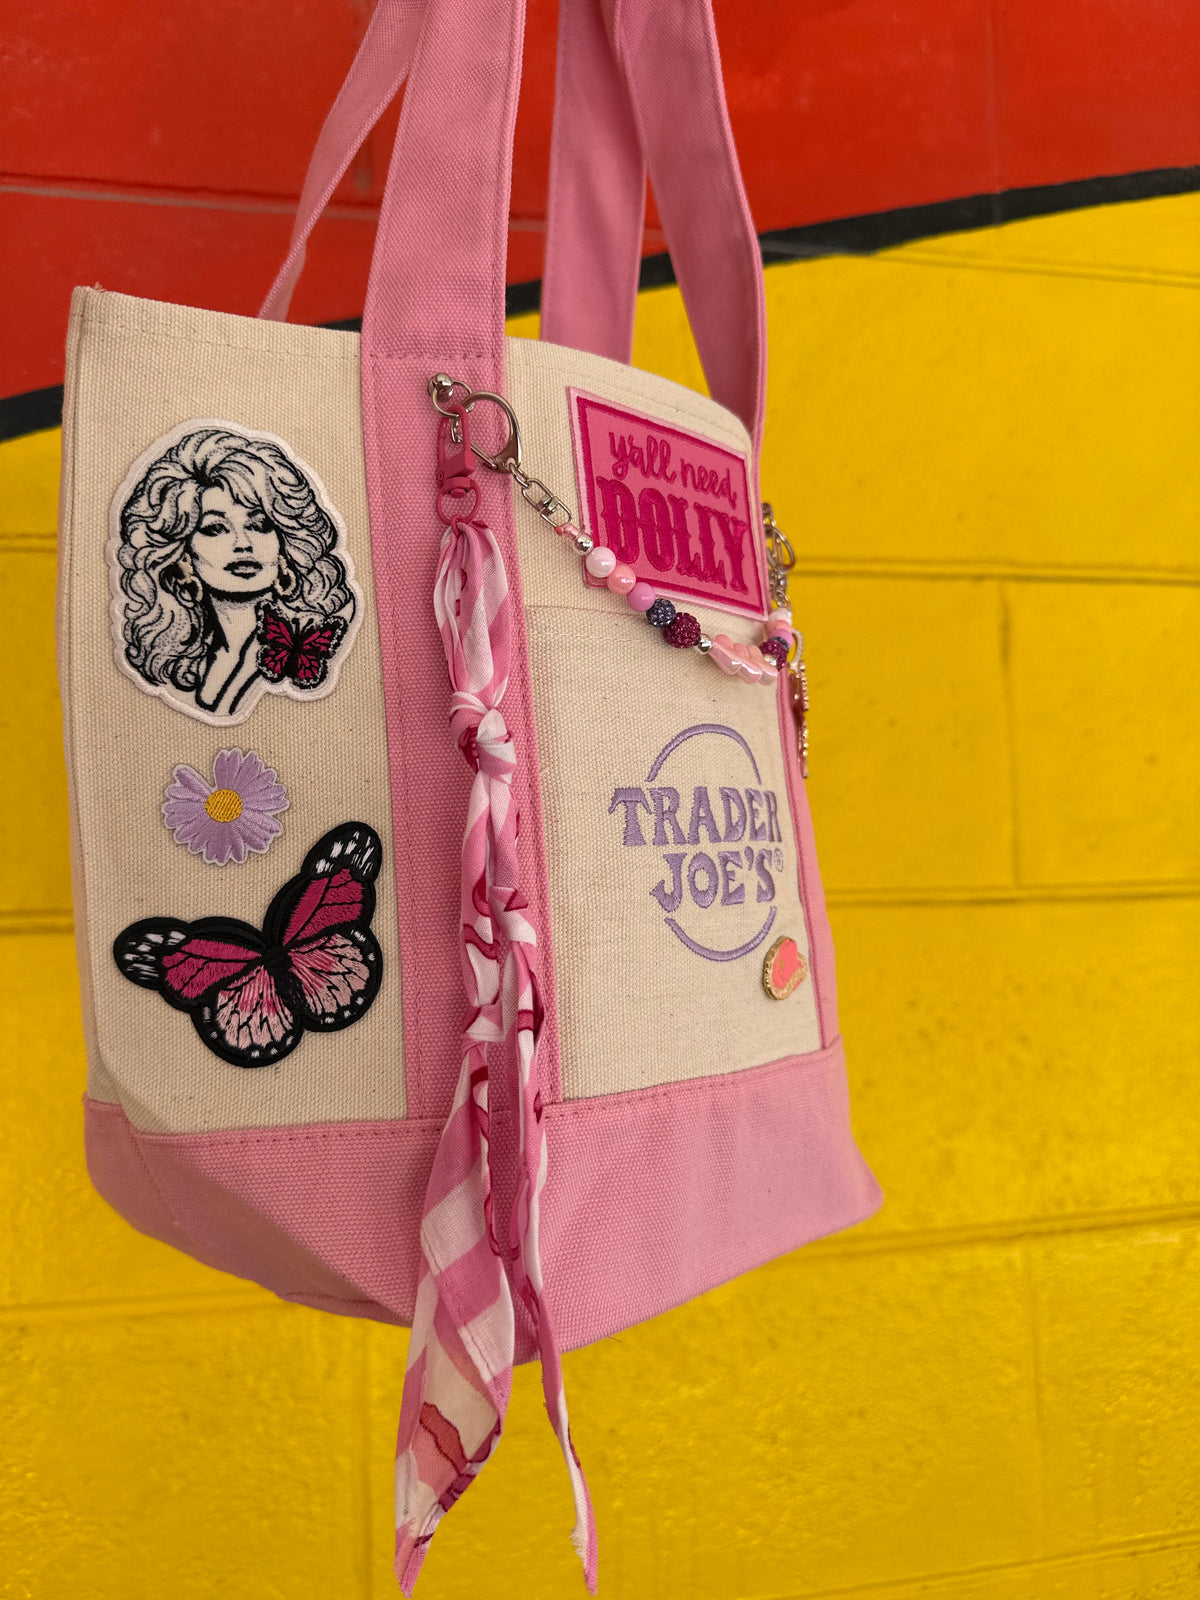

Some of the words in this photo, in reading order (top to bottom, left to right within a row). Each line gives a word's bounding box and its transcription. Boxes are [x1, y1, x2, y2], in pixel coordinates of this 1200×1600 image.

[680, 458, 737, 510] need
[596, 475, 749, 595] DOLLY
[608, 786, 783, 846] TRADER
[649, 846, 776, 913] JOE'S
